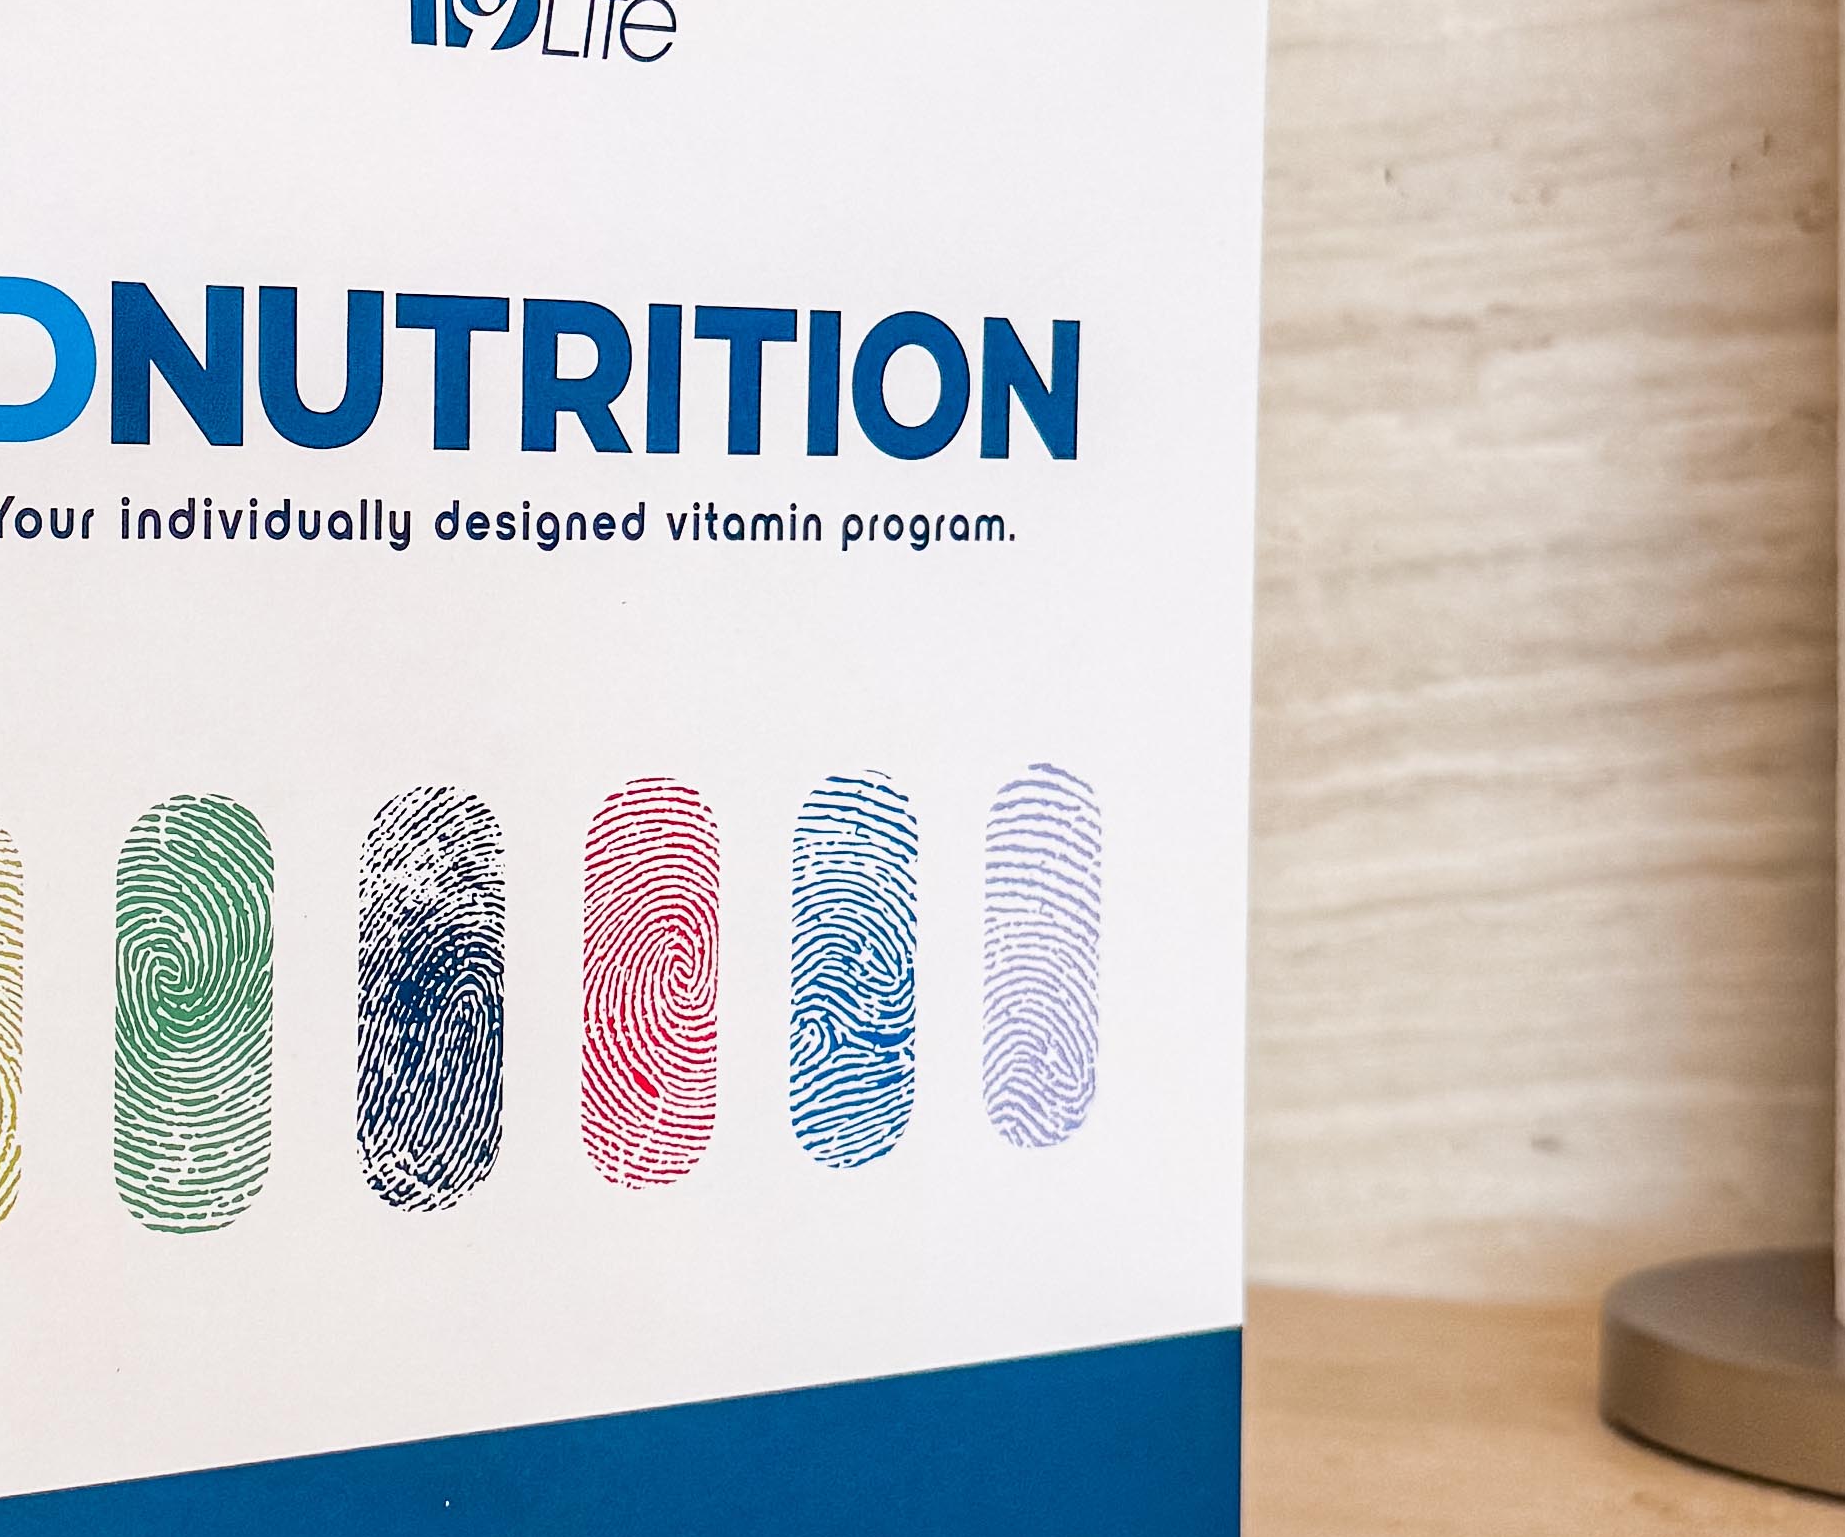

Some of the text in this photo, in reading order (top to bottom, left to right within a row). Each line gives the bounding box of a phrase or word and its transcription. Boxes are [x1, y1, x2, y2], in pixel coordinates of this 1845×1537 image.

[121, 496, 411, 552] individually
[435, 500, 645, 552] designed
[666, 501, 822, 541] vitamin
[841, 513, 1016, 551] program.
